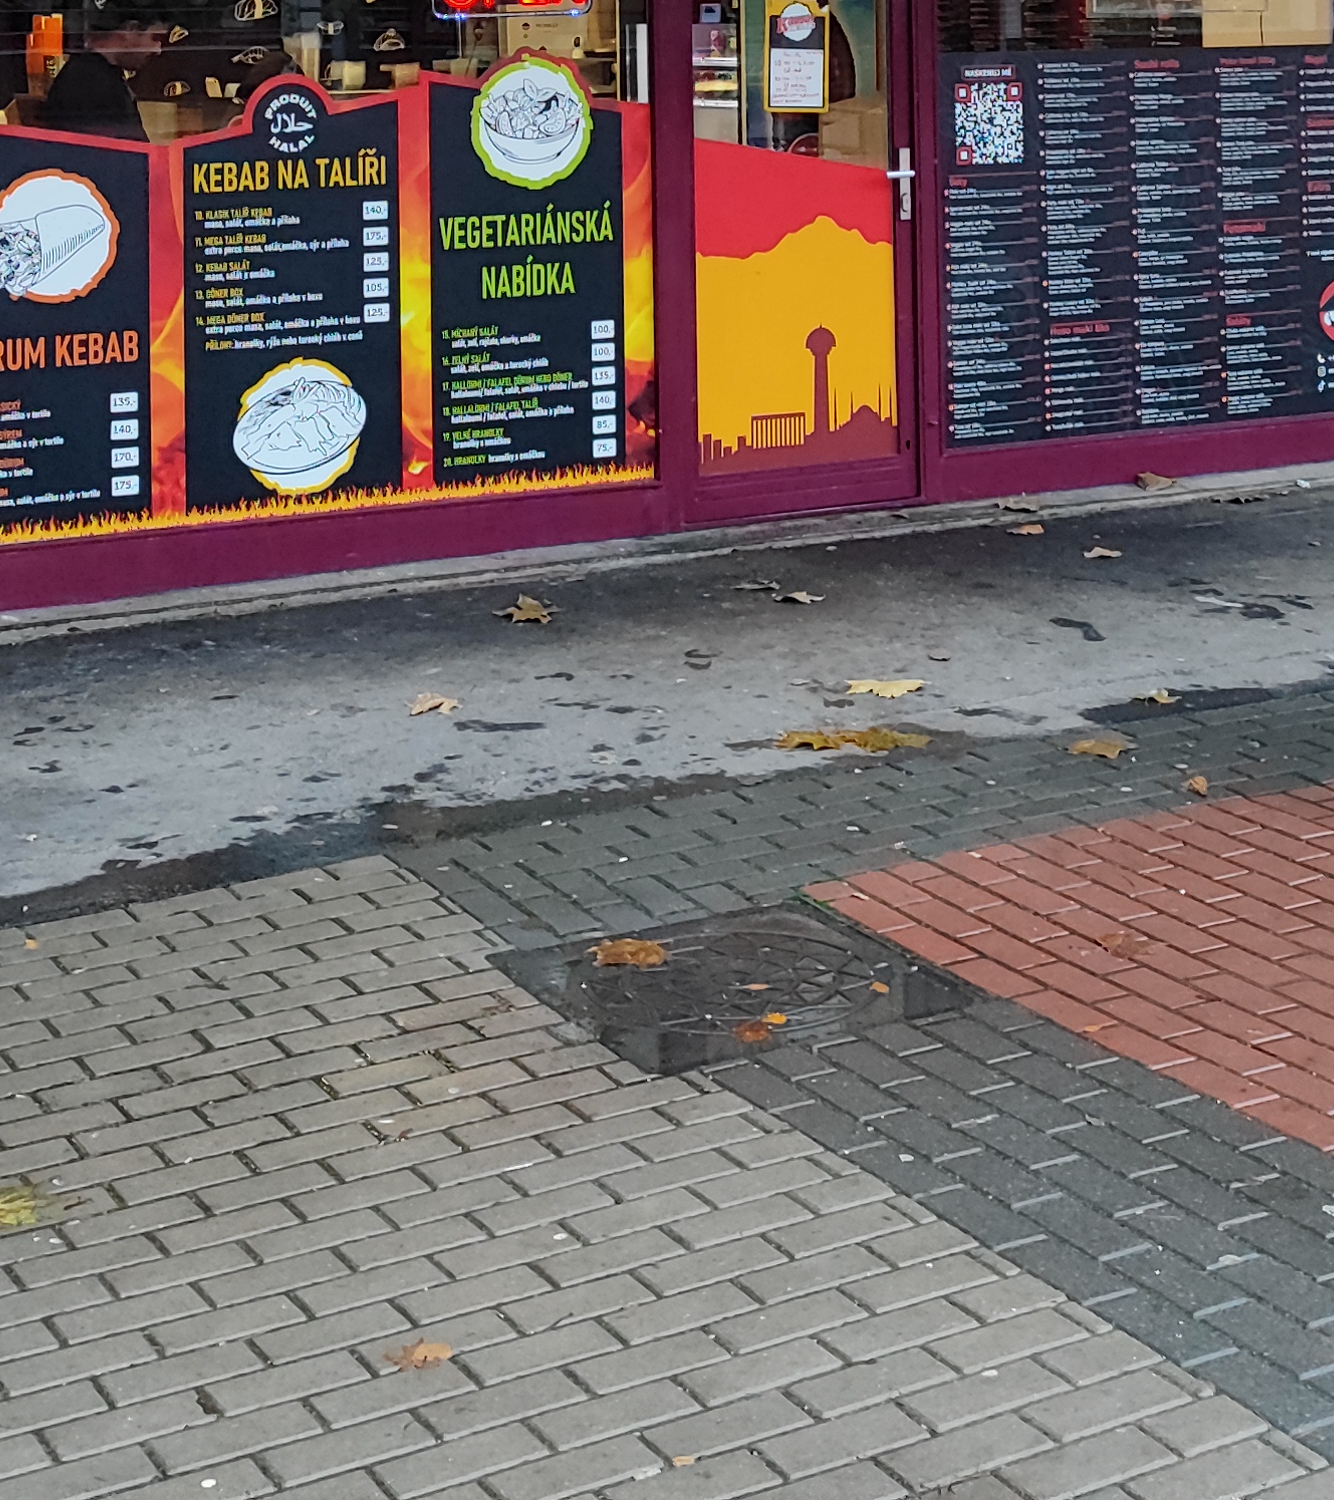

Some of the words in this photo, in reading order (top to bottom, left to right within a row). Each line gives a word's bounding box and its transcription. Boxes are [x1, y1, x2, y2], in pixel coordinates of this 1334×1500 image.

[264, 93, 317, 120] PRODUIT
[270, 112, 314, 134] حلال
[268, 133, 316, 153] HALAL
[193, 160, 269, 194] KEBAB
[277, 158, 310, 190] NA
[315, 147, 387, 188] TALÍŘI
[439, 199, 614, 251] VEGETARIÁNSKÁ
[481, 254, 577, 300] NABÍDKA
[55, 329, 139, 368] KEBAB
